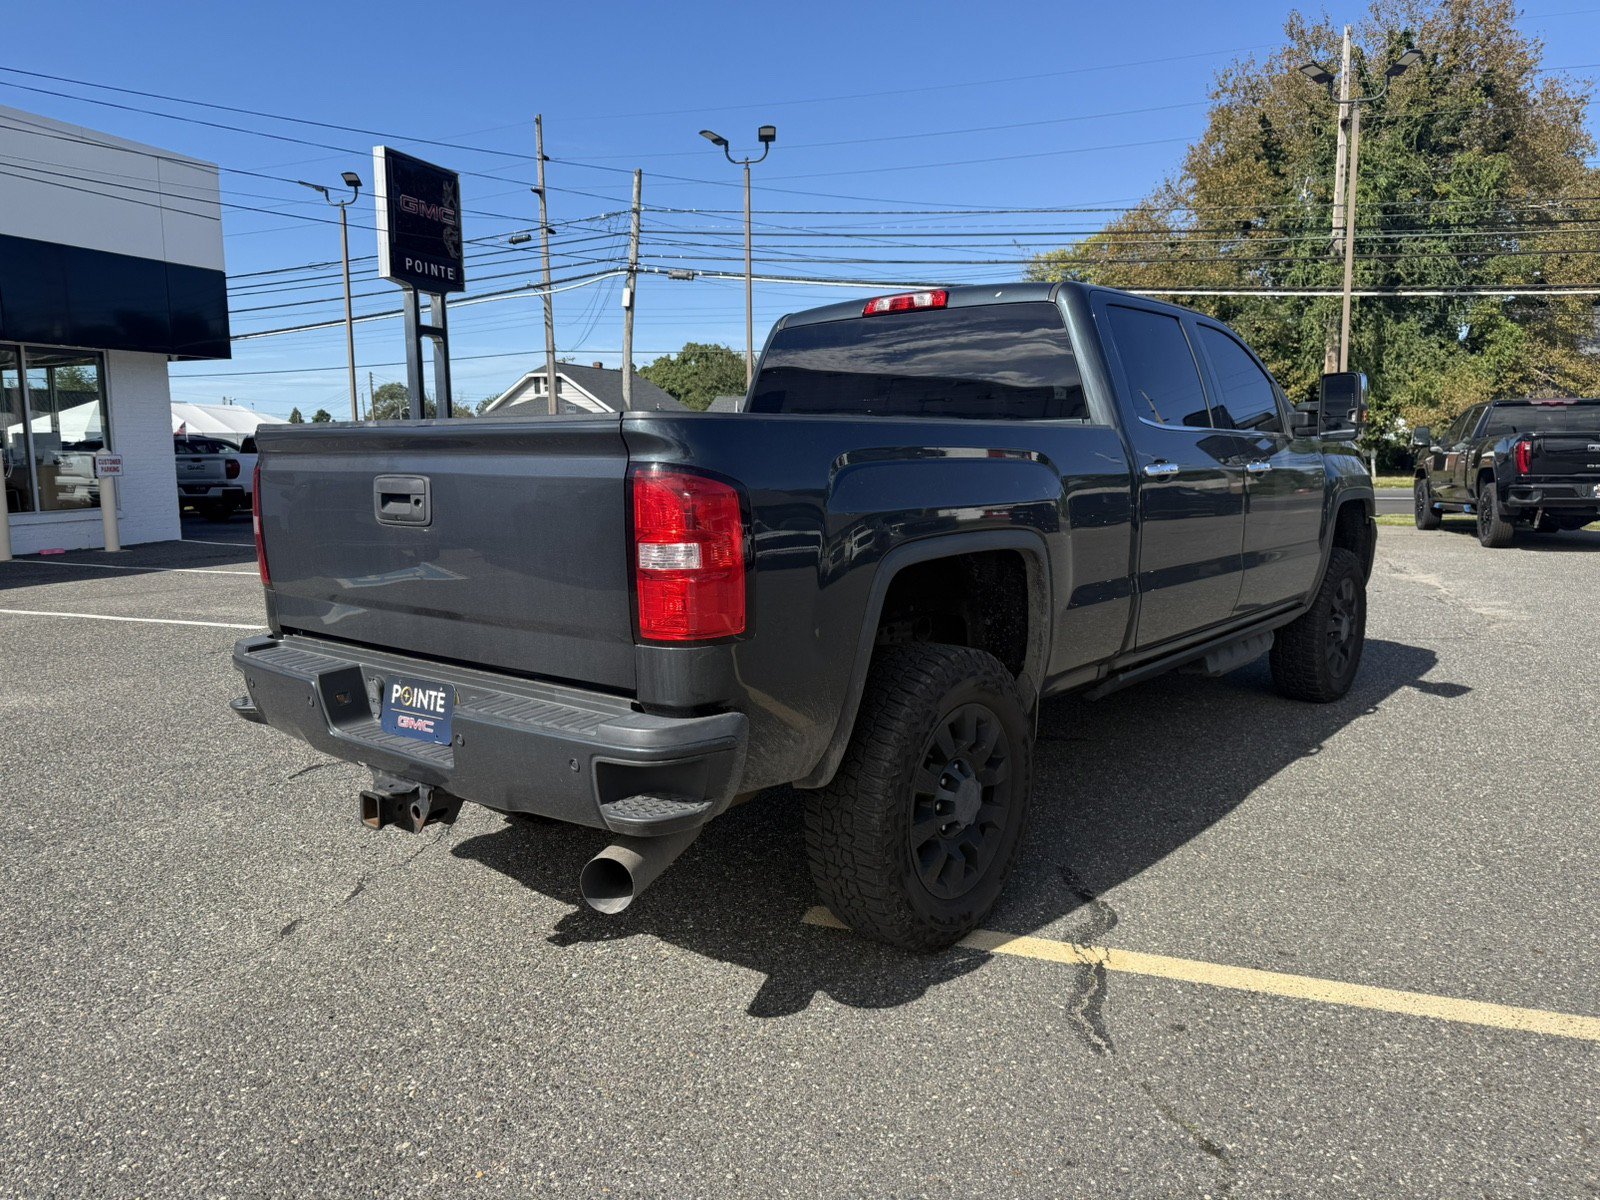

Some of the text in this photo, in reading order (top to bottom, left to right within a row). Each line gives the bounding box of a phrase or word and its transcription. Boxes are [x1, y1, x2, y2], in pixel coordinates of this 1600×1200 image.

[400, 193, 455, 225] GMC
[405, 257, 455, 280] POINTE
[391, 684, 446, 713] POINTE
[397, 715, 435, 733] GMC
